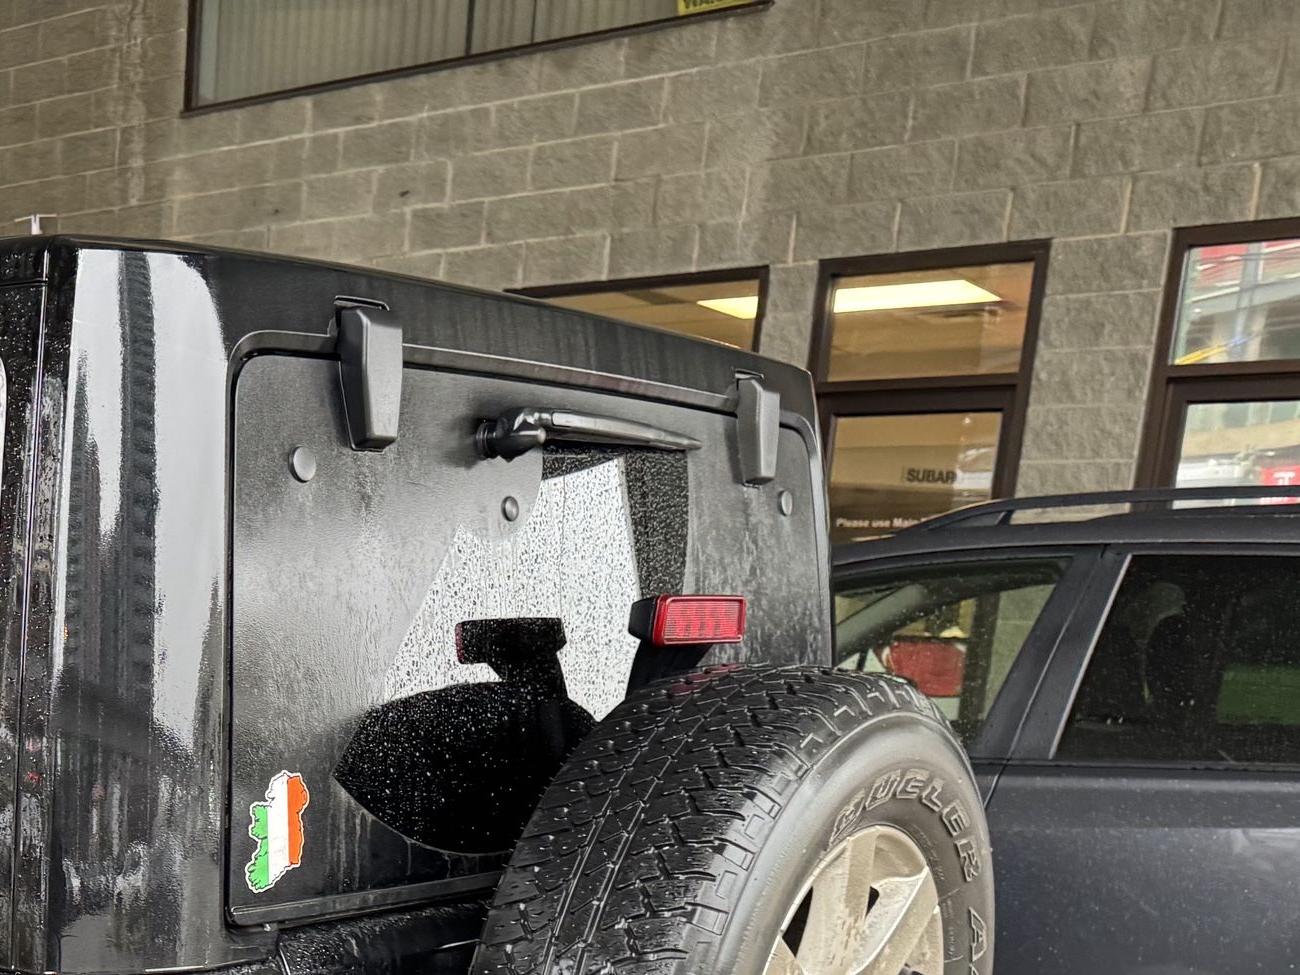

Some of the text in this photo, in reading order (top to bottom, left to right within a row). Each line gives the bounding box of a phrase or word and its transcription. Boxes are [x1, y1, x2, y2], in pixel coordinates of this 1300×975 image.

[906, 468, 957, 484] SUBAR
[836, 517, 870, 528] Please
[872, 520, 890, 528] use
